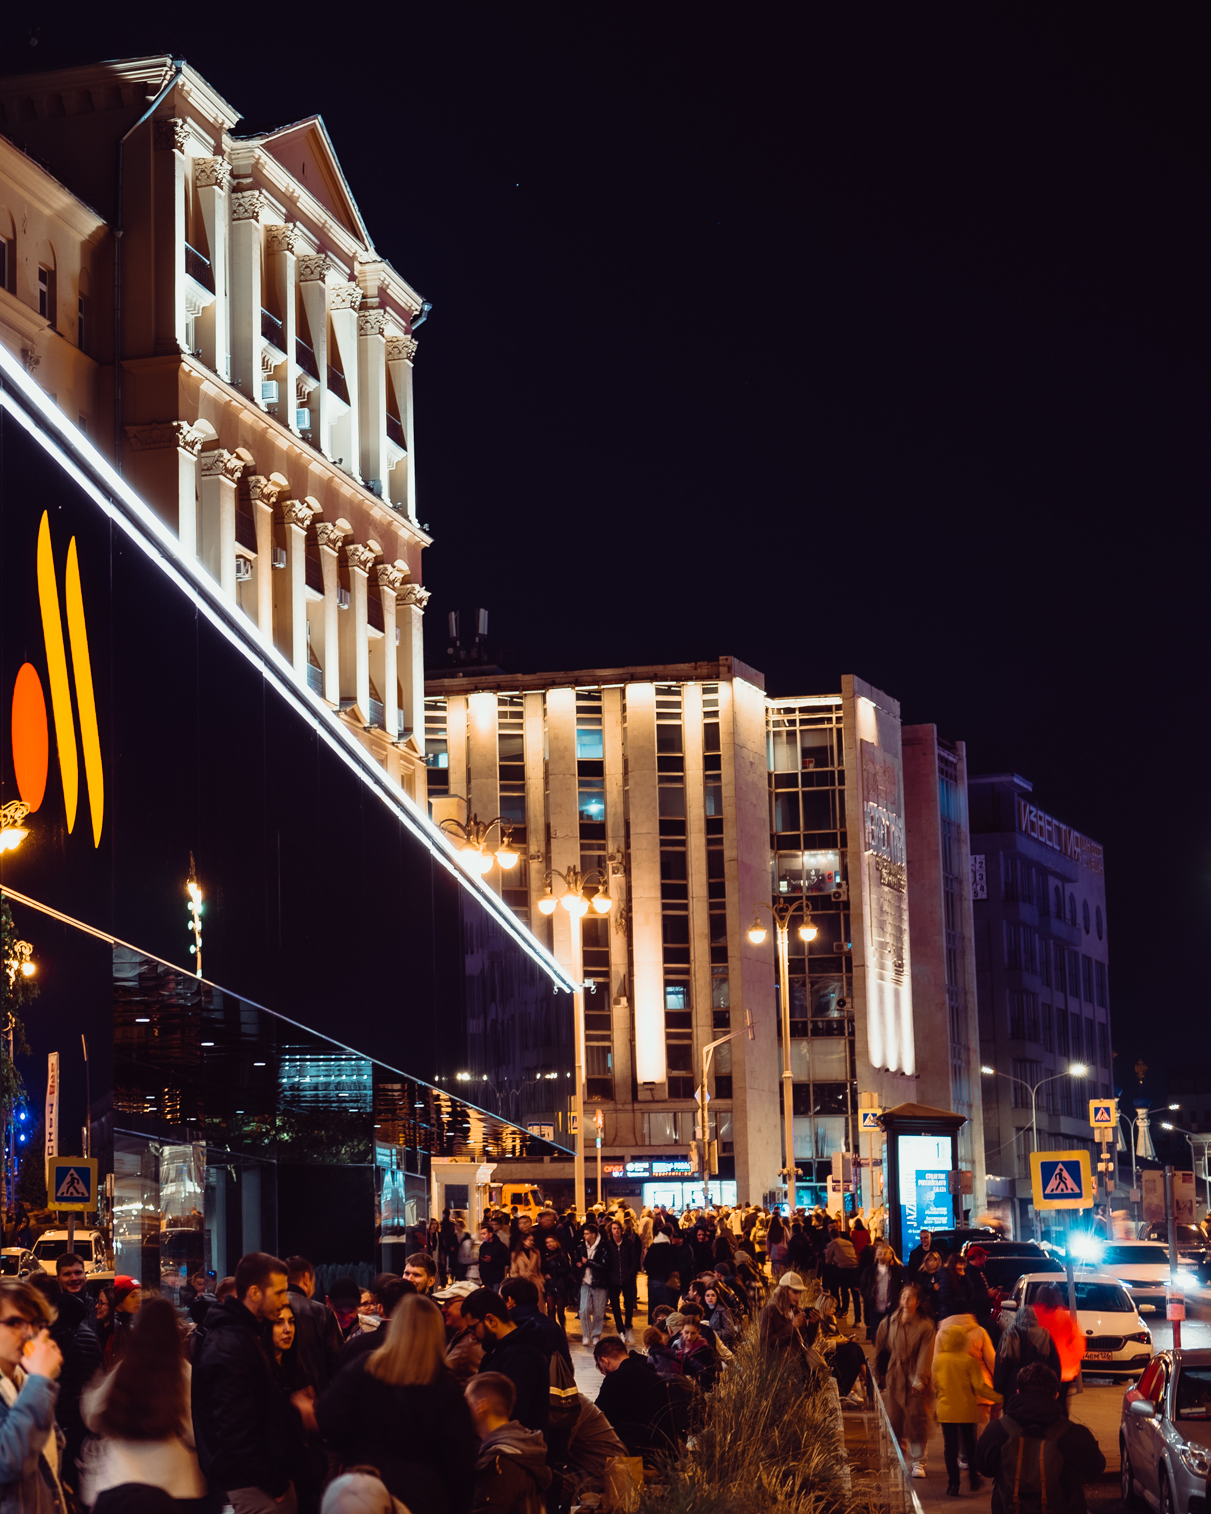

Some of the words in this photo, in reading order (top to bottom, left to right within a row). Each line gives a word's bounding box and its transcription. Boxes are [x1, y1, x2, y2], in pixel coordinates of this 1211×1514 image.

[1019, 800, 1082, 862] ИЗВЕСТИЯ
[978, 873, 984, 881] 3
[979, 885, 985, 893] 4
[973, 890, 979, 898] 5
